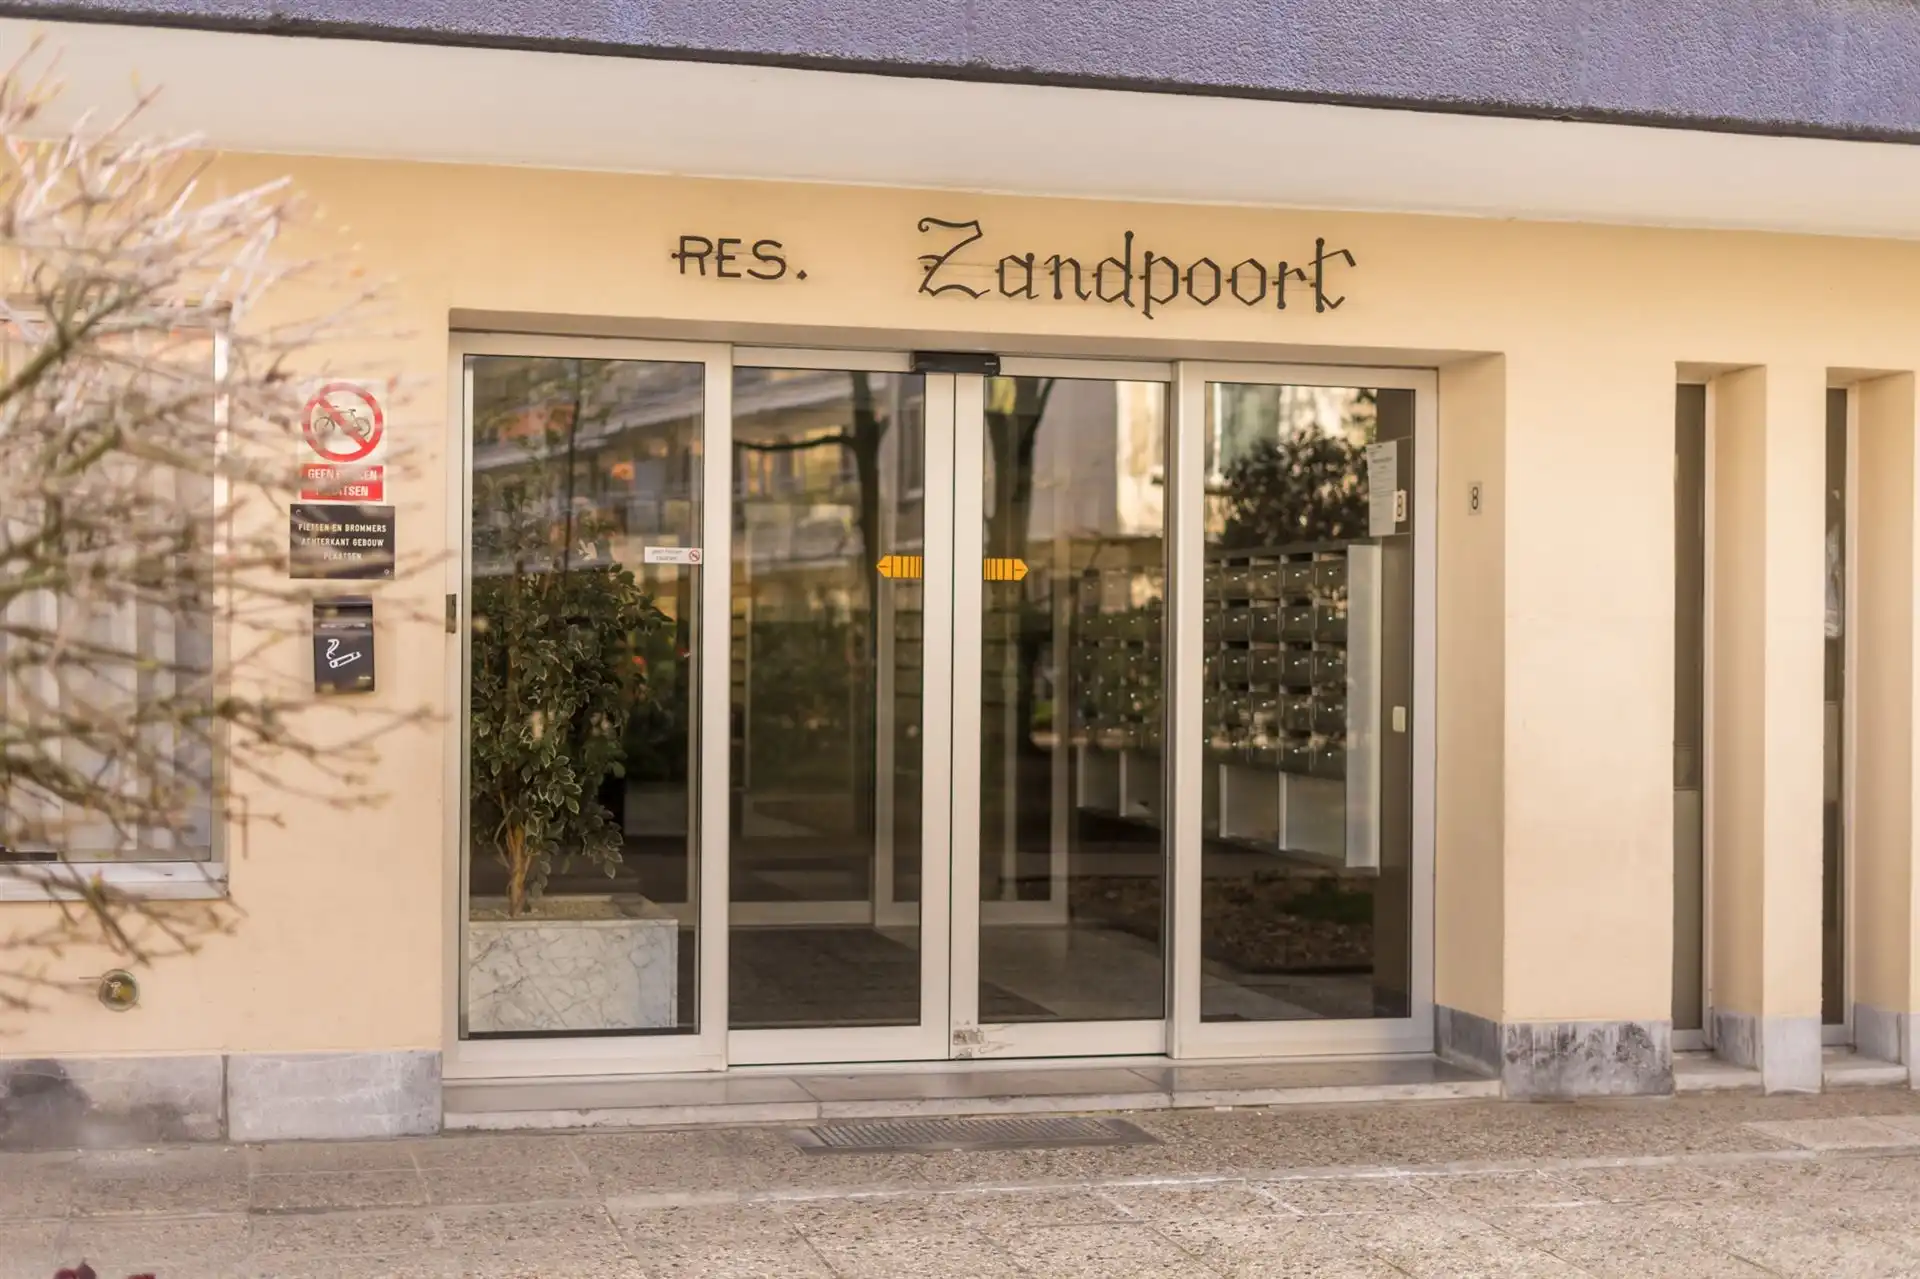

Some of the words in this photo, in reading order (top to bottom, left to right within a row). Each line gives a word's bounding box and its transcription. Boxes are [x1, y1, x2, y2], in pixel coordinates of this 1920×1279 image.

[671, 235, 808, 280] RES.
[917, 217, 1357, 320] Zandpoort
[307, 468, 335, 480] GEEN
[1471, 486, 1479, 510] 8
[331, 524, 342, 533] EN
[344, 524, 387, 533] BROMMERS
[352, 538, 385, 548] GEBOUW
